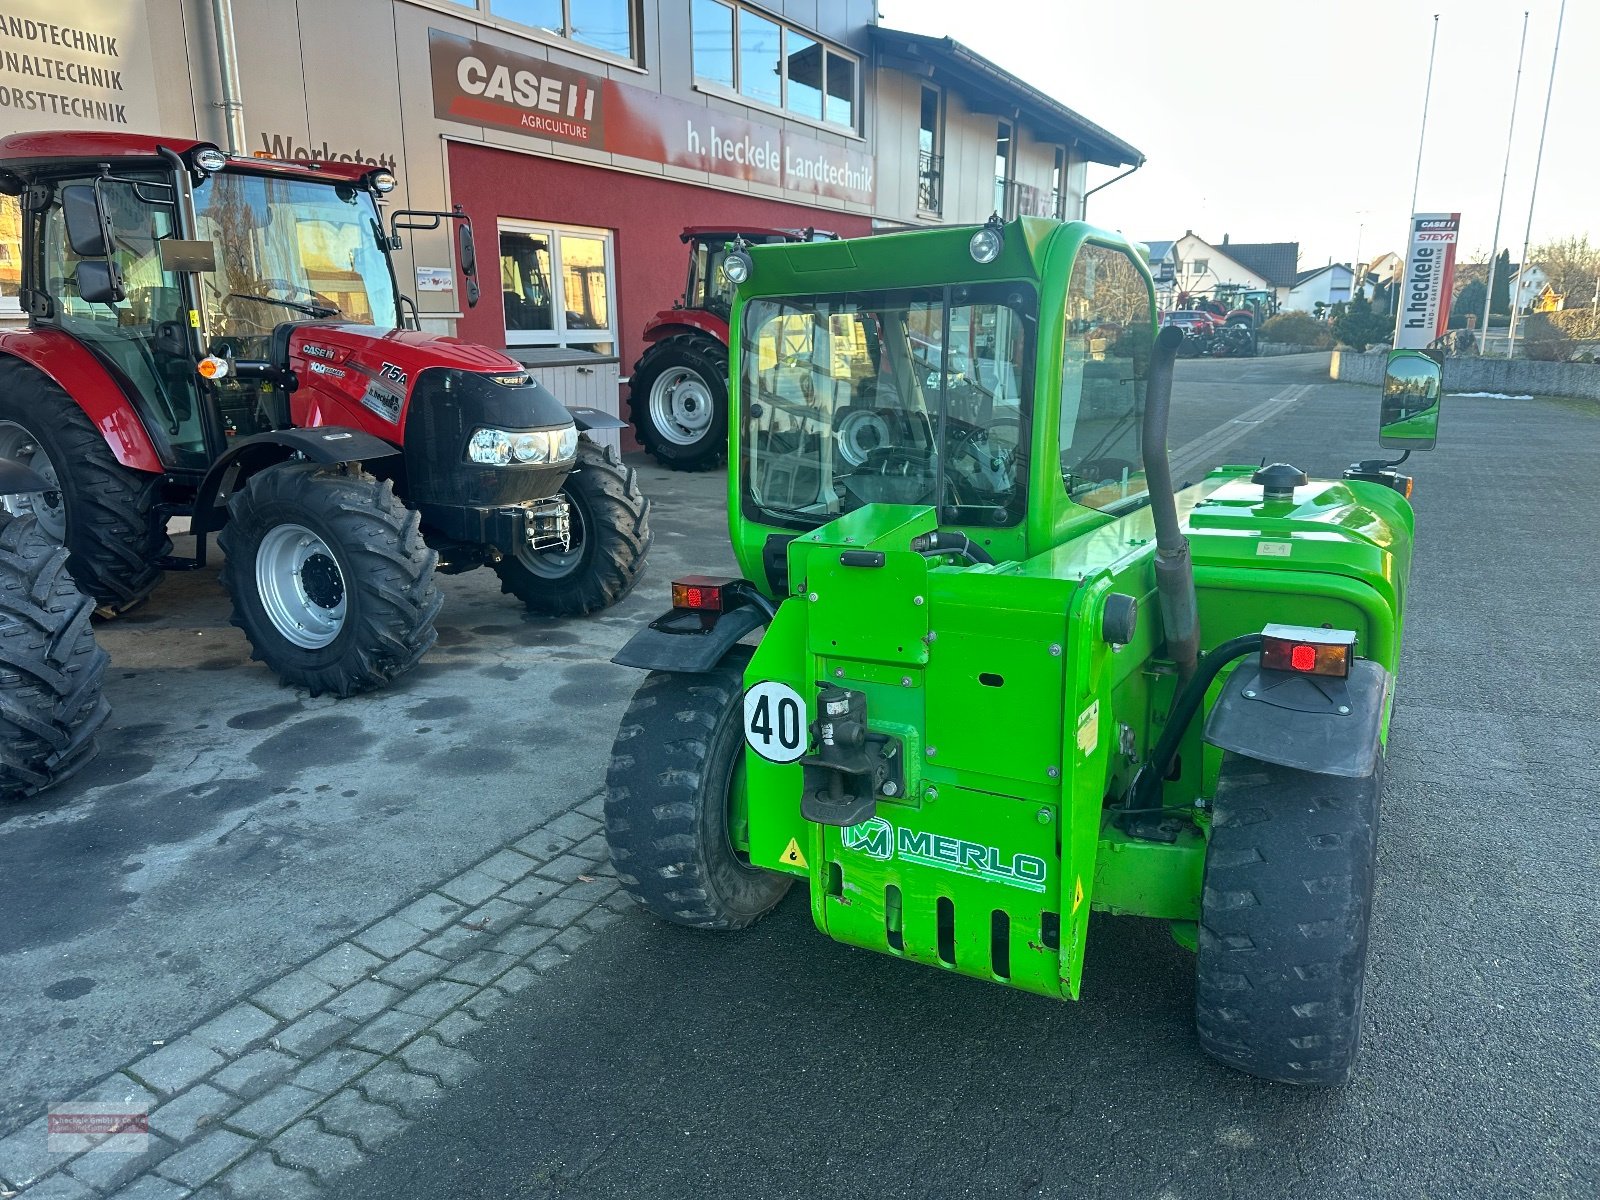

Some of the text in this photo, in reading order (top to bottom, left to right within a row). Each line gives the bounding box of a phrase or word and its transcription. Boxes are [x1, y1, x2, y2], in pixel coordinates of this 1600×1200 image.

[0, 50, 123, 91] NALTECHNIK
[457, 56, 563, 114] CASE
[521, 114, 588, 139] AGRICULTURE
[687, 119, 872, 192] h. heckele Landtechnik
[1417, 233, 1455, 241] STEYR
[1405, 247, 1434, 329] h.heckele
[302, 344, 326, 357] CASE
[379, 361, 408, 385] 75A
[750, 694, 799, 750] 40
[898, 827, 1046, 883] MERLO
